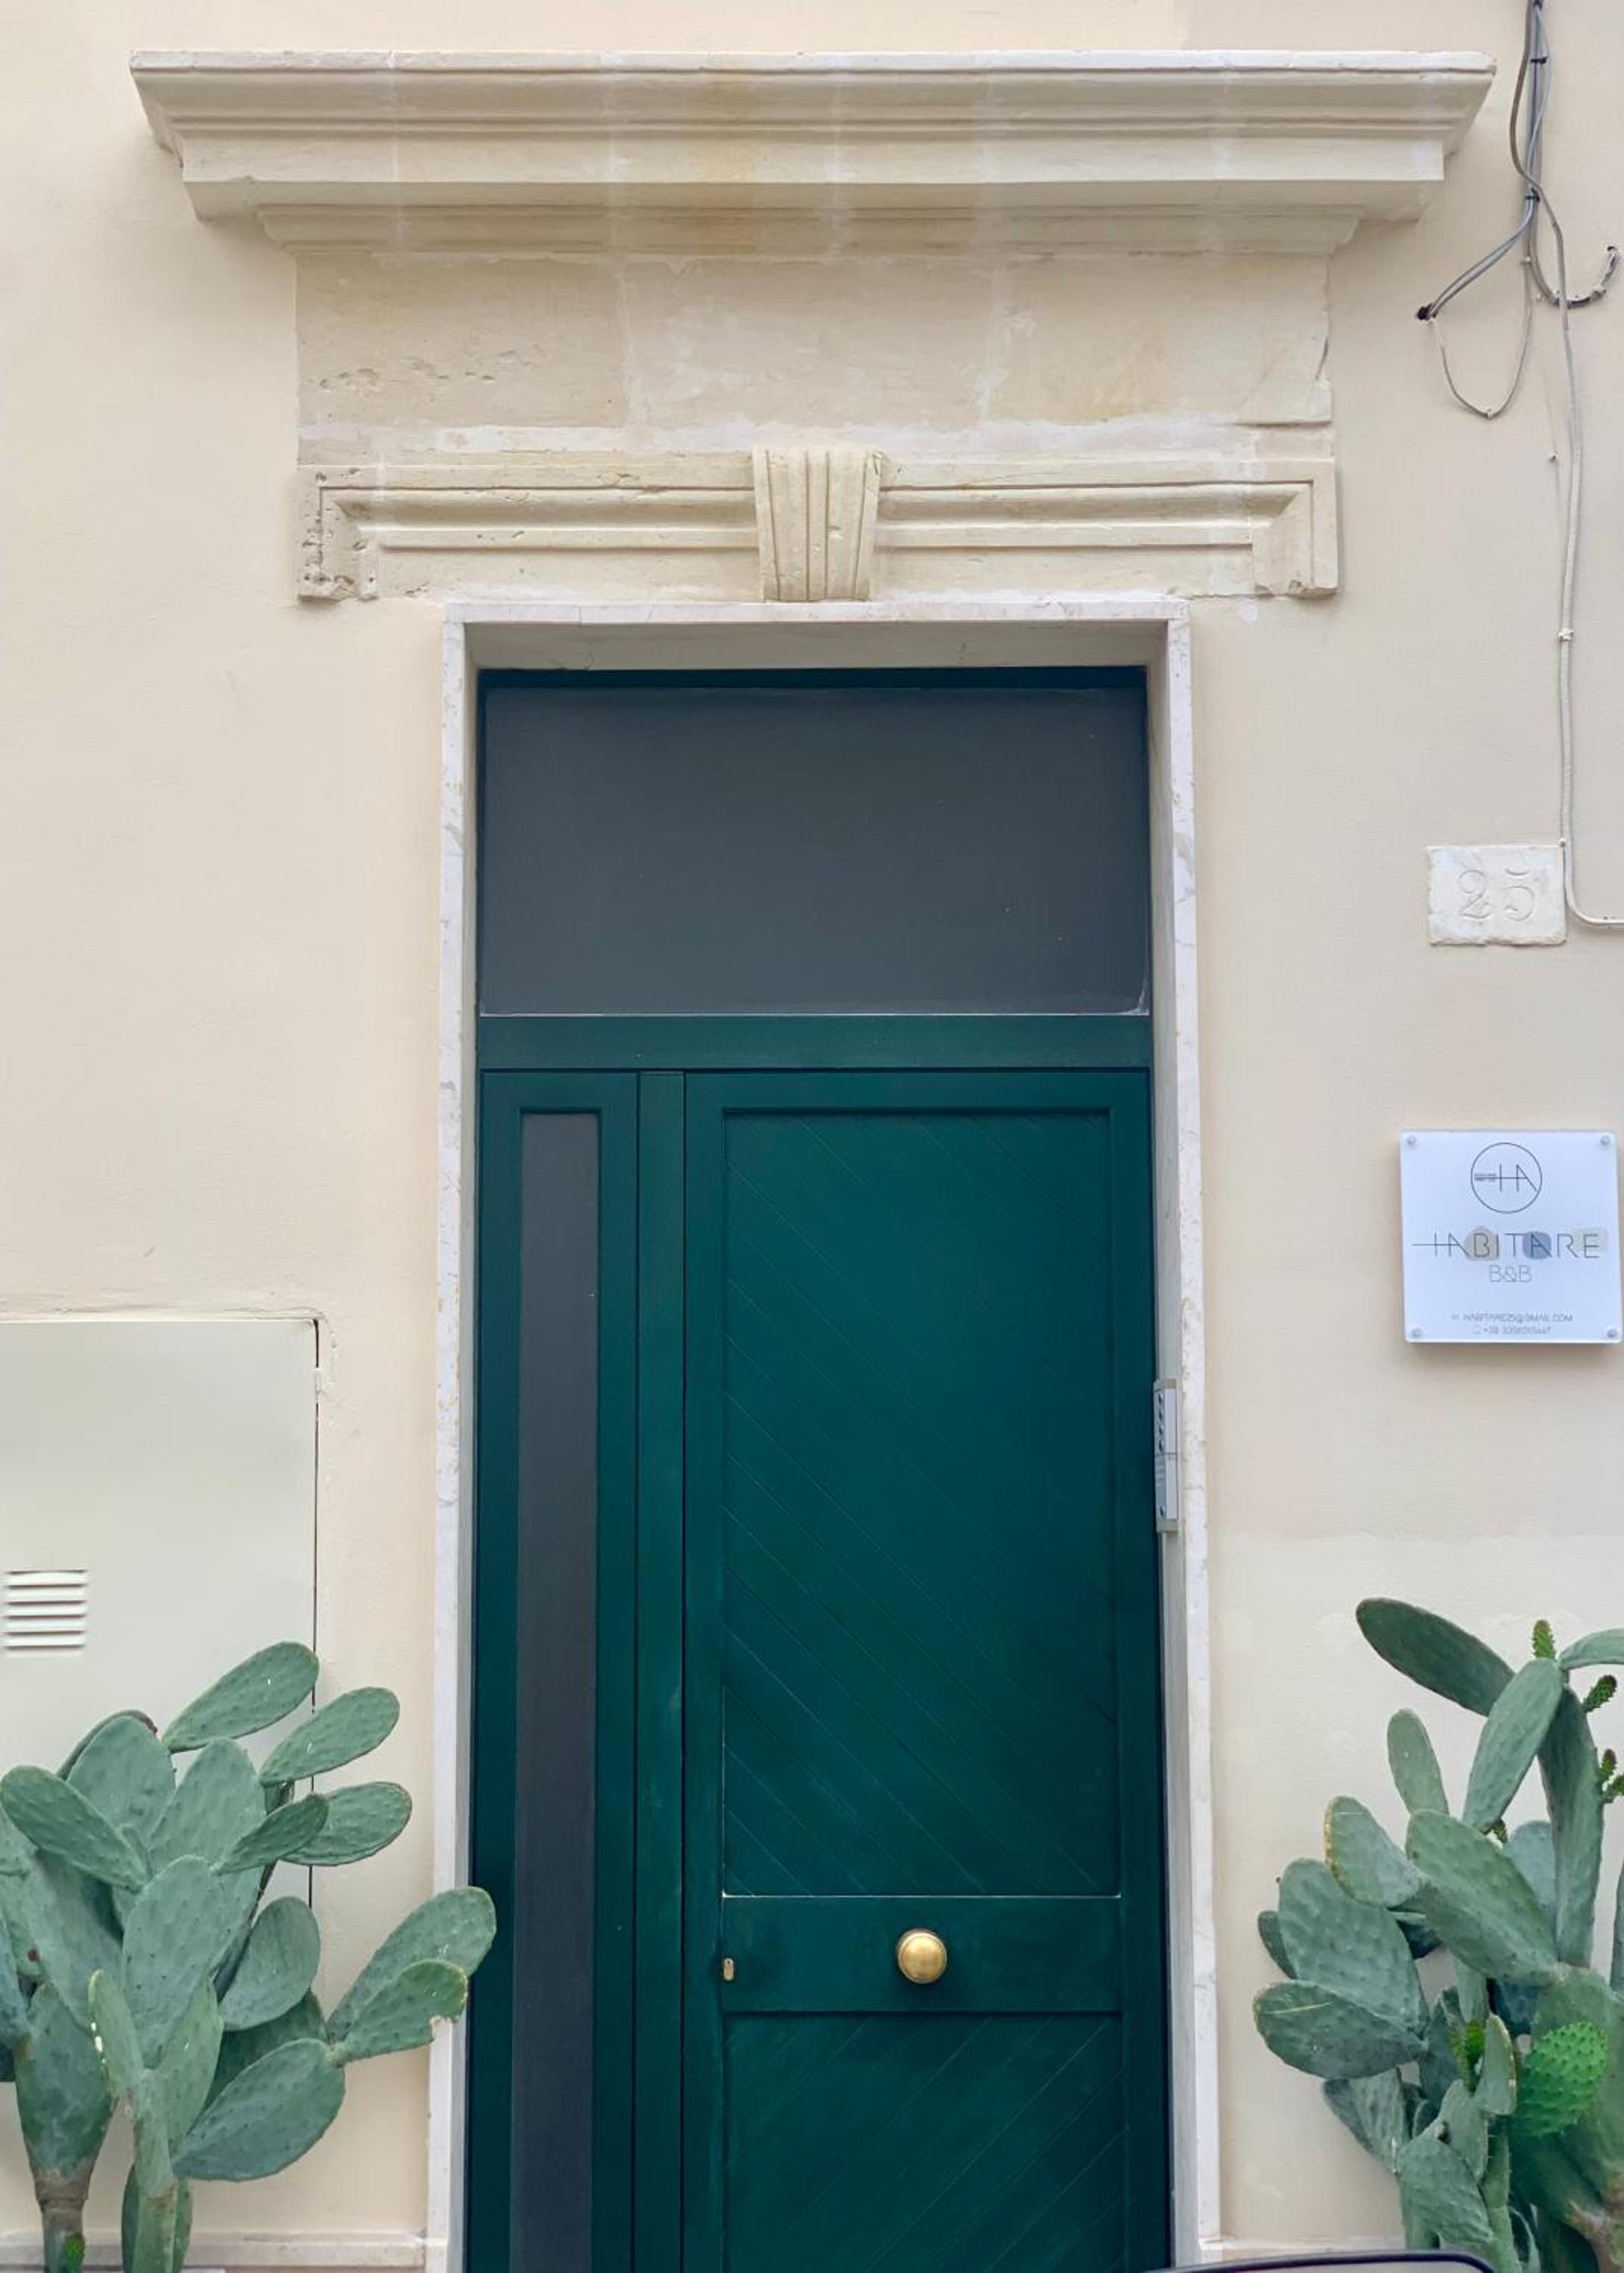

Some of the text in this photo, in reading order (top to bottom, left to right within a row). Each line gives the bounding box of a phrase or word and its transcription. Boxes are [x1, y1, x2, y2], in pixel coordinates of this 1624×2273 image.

[1457, 868, 1535, 922] 25
[1413, 1232, 1601, 1258] HABITARE
[1489, 1265, 1532, 1282] B&B
